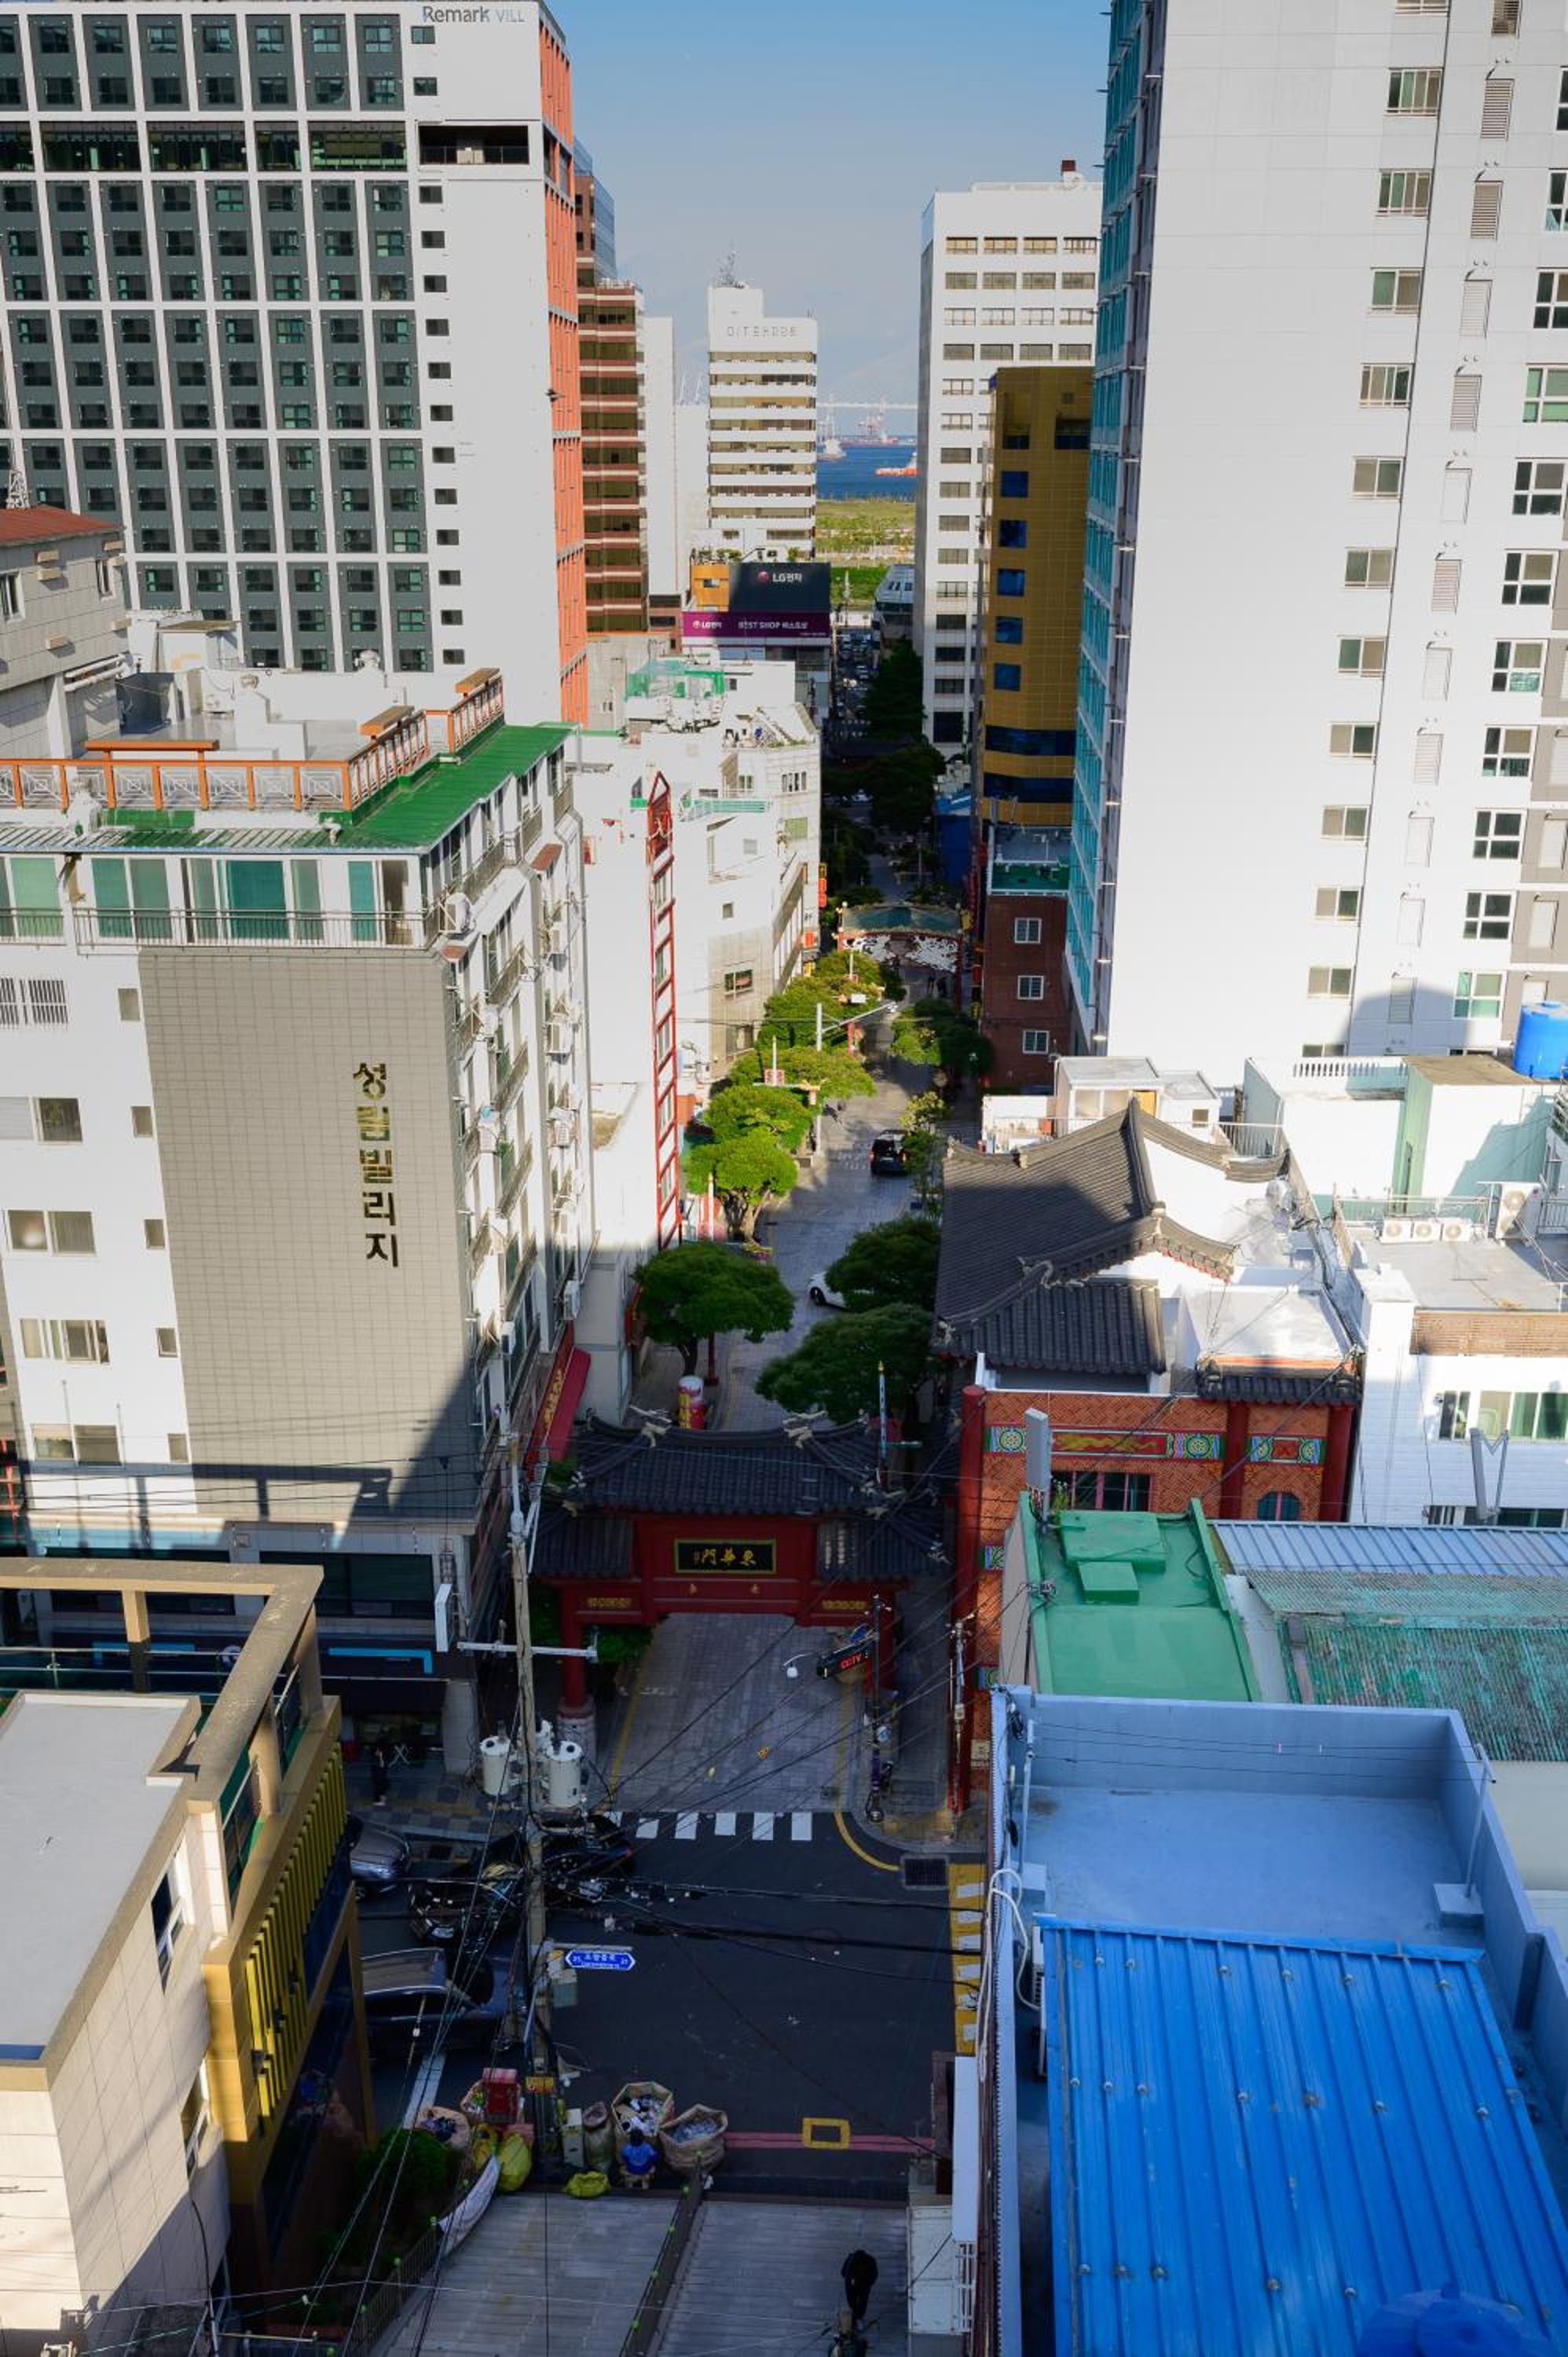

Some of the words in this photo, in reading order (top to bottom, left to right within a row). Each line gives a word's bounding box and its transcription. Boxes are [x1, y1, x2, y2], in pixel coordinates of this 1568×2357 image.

[423, 6, 490, 23] Remark
[495, 9, 526, 23] VILL
[738, 621, 757, 629] BEST
[759, 621, 779, 629] SHOP
[841, 1651, 863, 1670] CCTV
